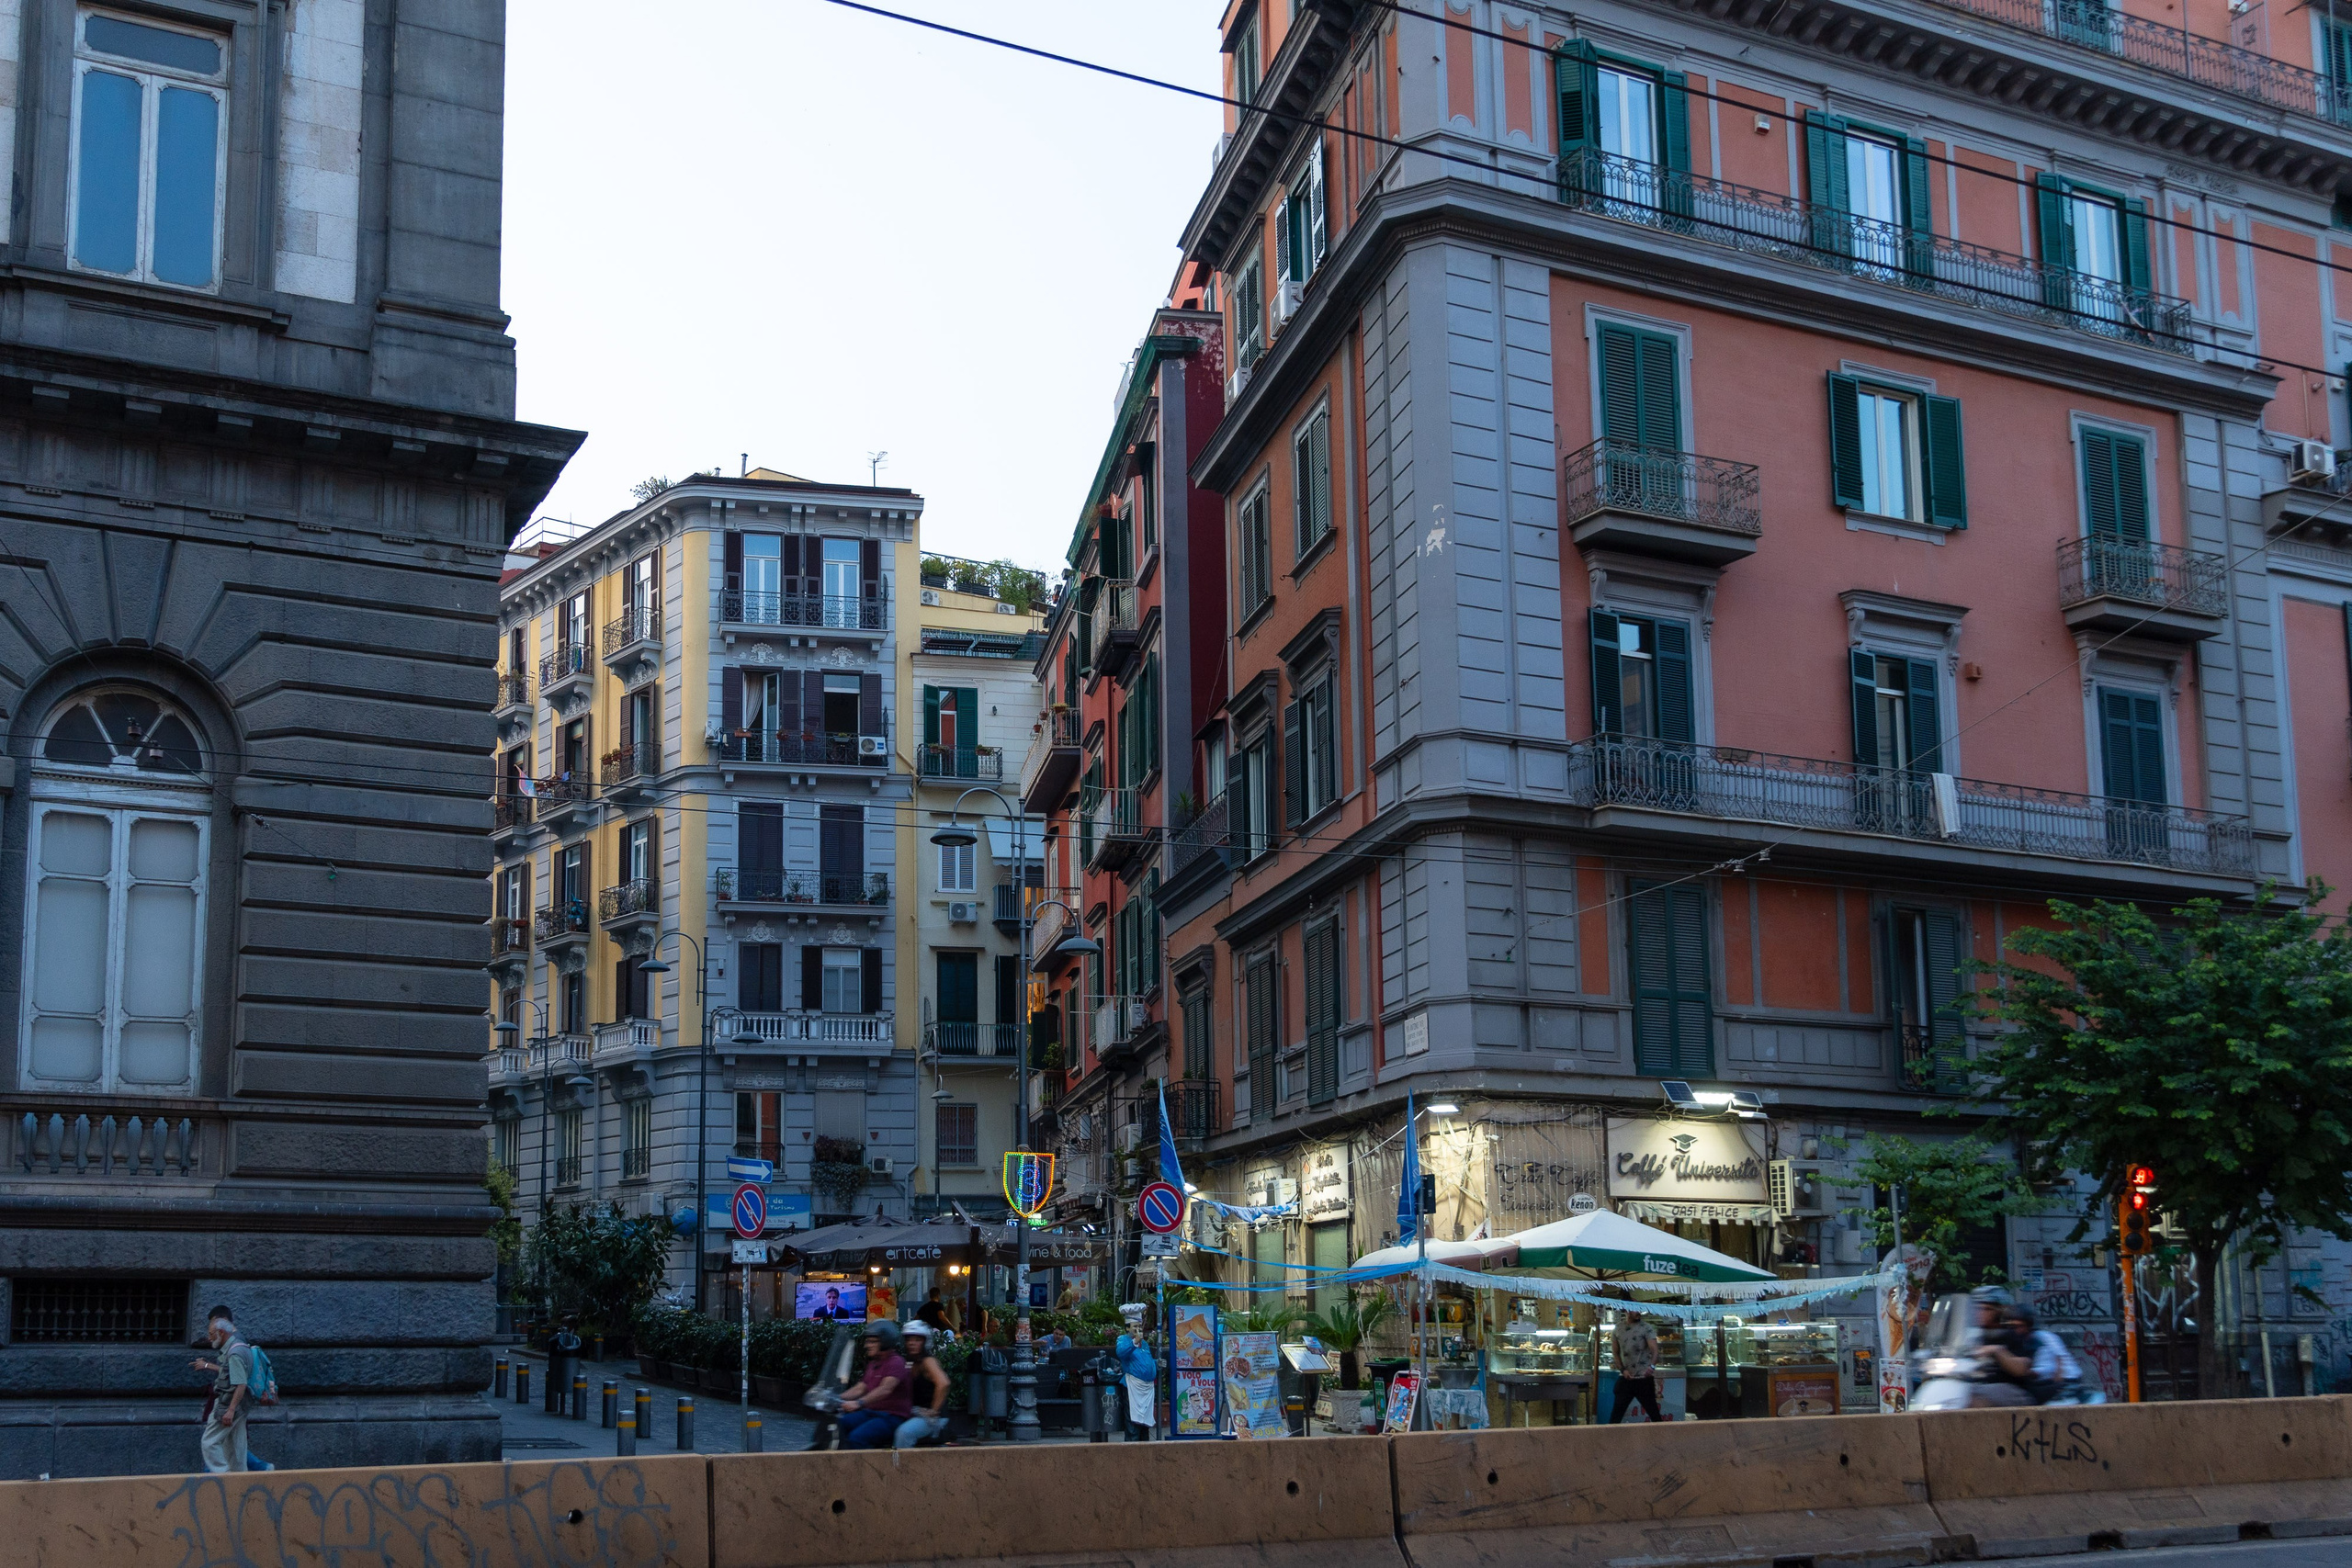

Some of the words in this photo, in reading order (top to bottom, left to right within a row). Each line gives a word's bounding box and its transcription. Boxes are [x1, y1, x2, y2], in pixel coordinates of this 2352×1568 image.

[1570, 1198, 1594, 1210] kenon
[1672, 1205, 1697, 1217] OASI
[1701, 1205, 1739, 1218] FELICE
[1065, 1247, 1092, 1258] food
[1182, 1371, 1202, 1380] VOLO
[1197, 1379, 1216, 1387] VOLO
